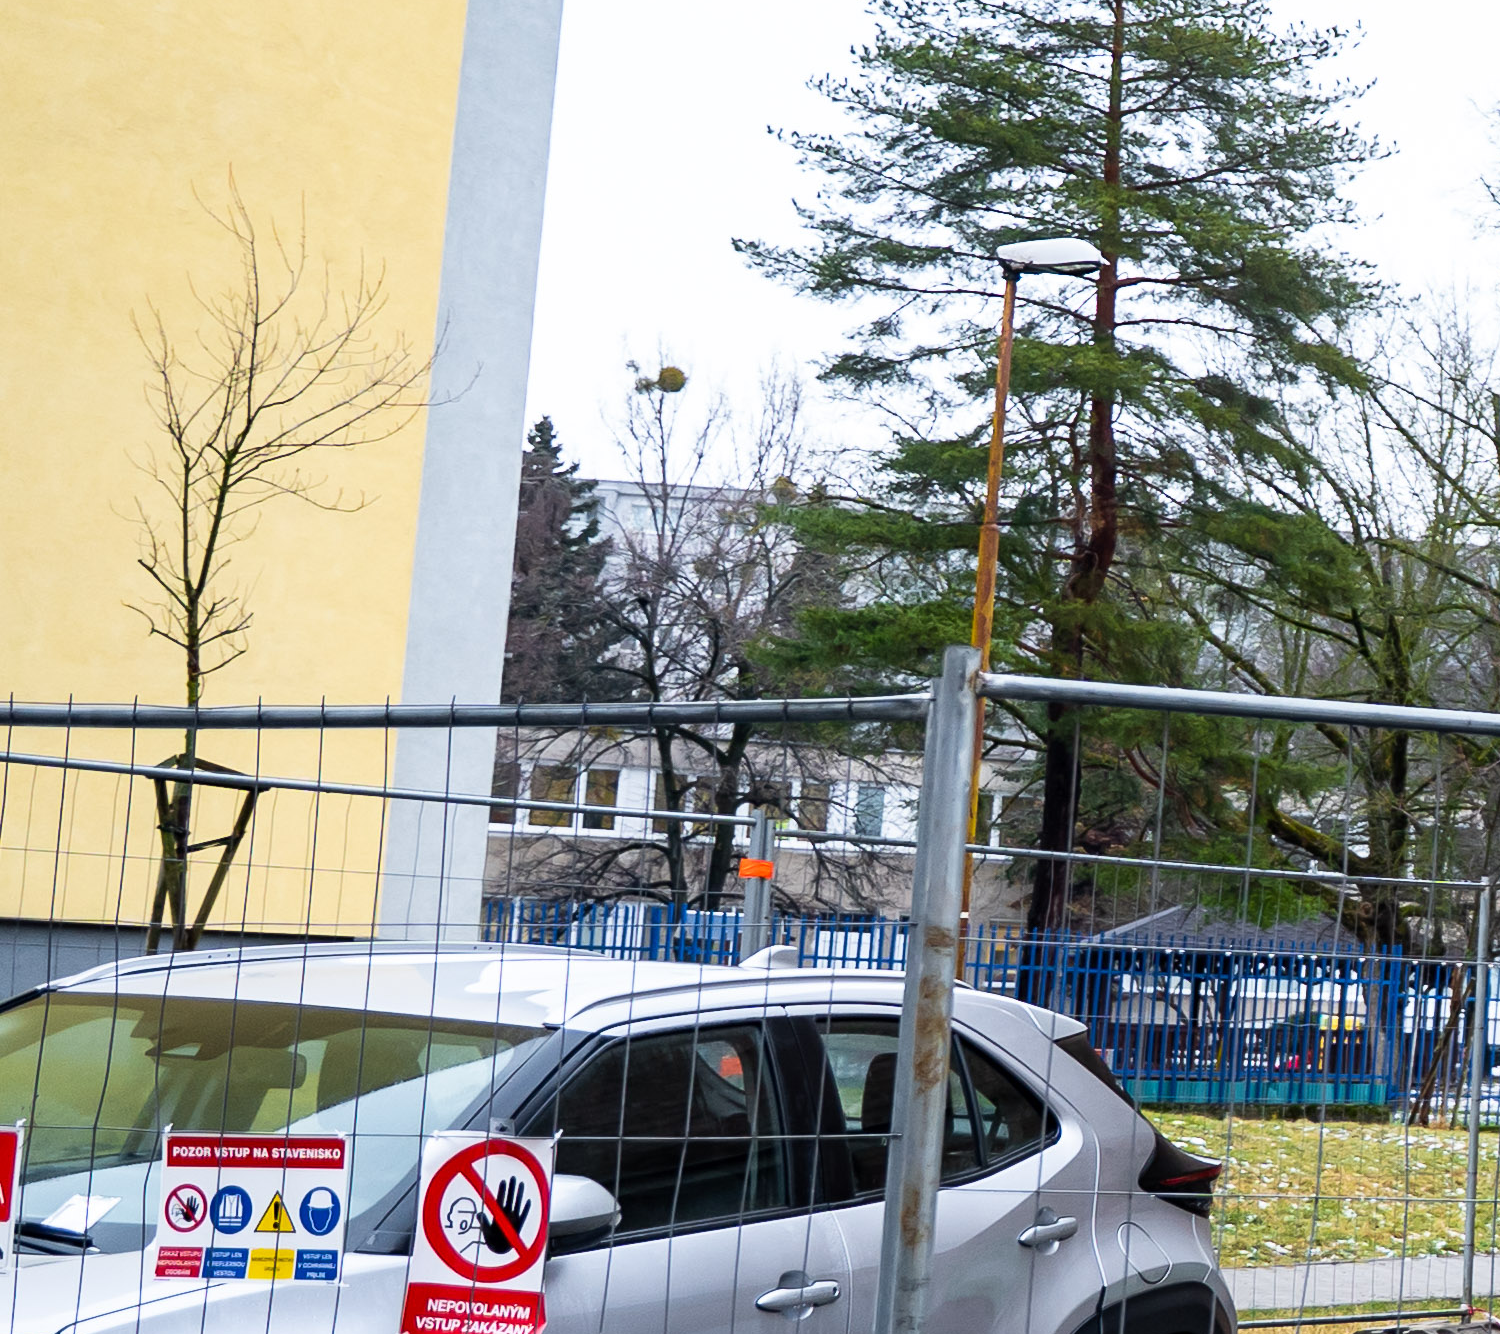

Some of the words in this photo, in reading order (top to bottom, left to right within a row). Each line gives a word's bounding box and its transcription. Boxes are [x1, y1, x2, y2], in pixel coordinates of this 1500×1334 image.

[172, 1146, 211, 1158] POZOR
[214, 1147, 250, 1158] VSTUP
[253, 1147, 268, 1158] NA
[272, 1147, 341, 1159] STAVENISKO
[427, 1298, 530, 1319] NEPOVOLANÝM
[416, 1316, 460, 1331] VSTUP
